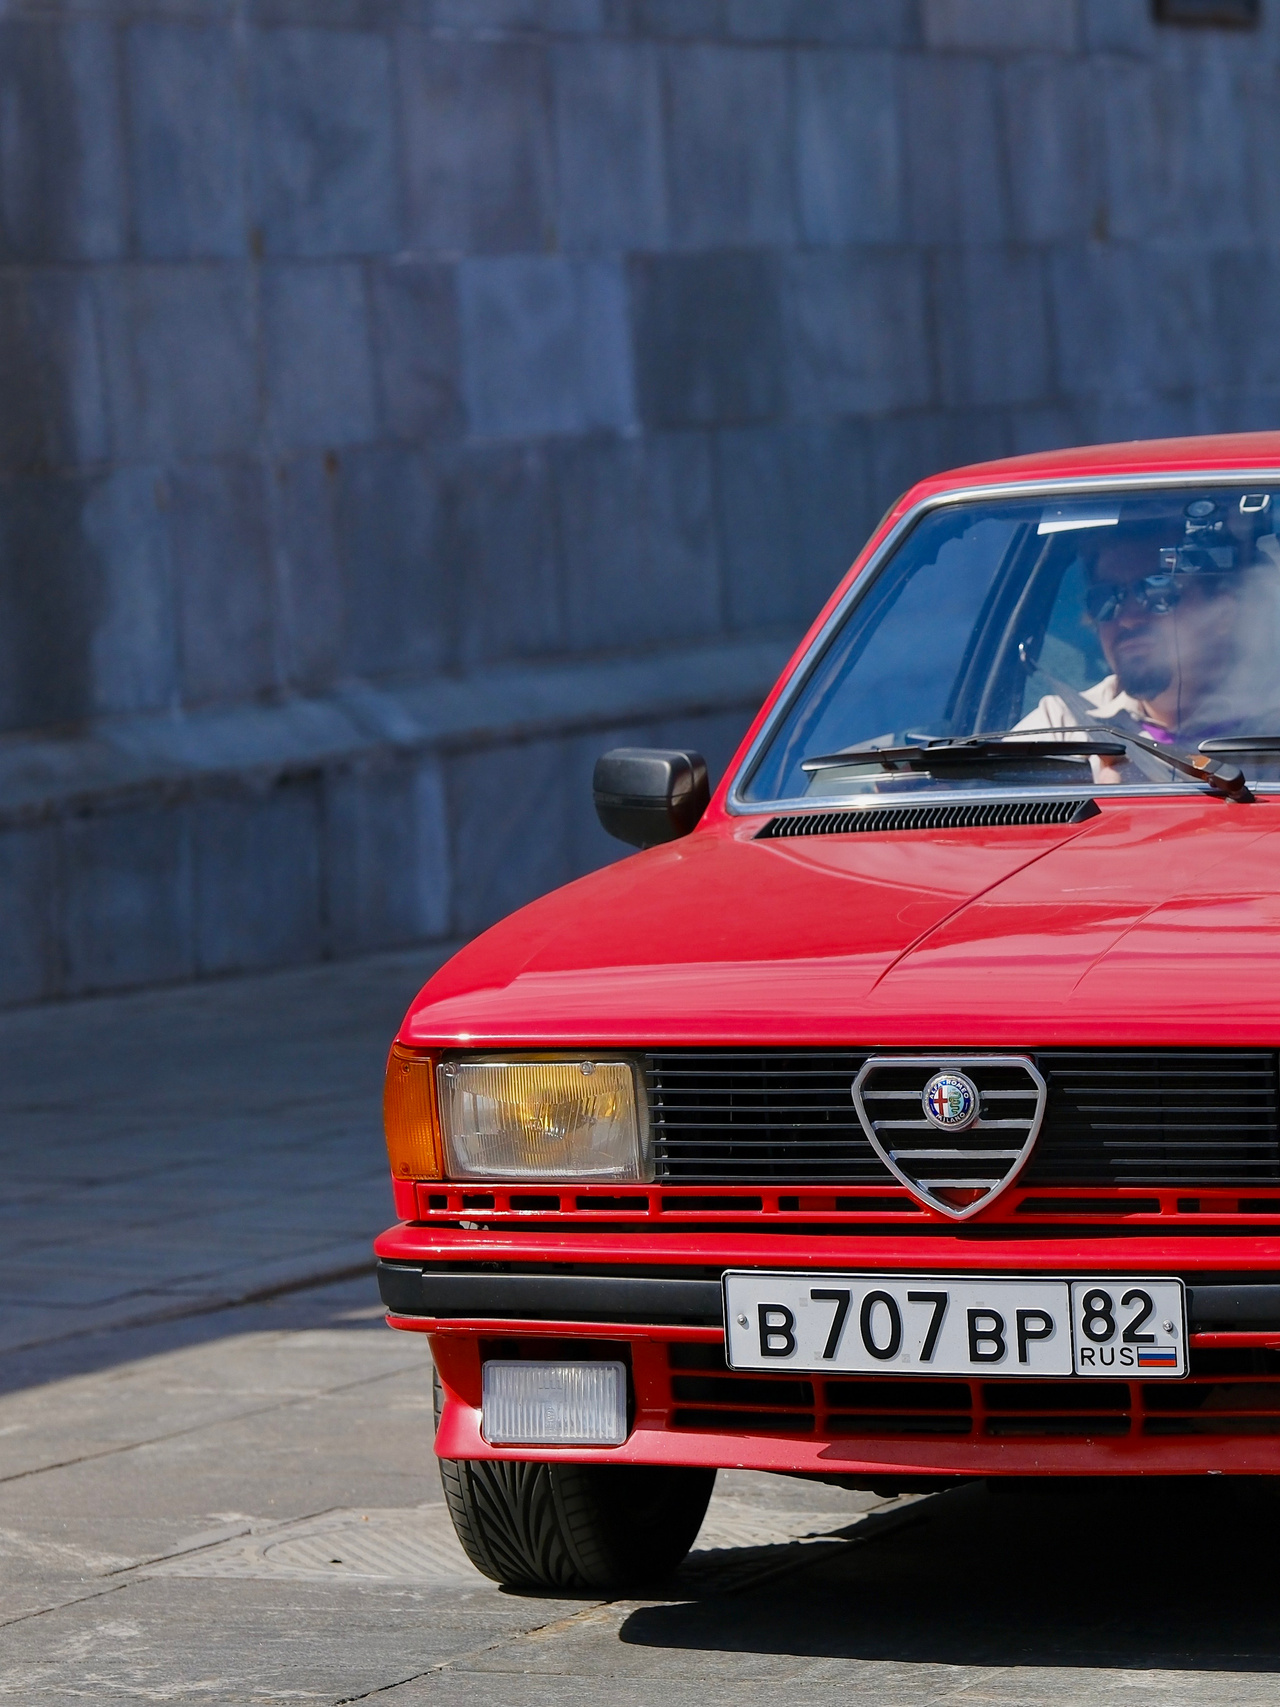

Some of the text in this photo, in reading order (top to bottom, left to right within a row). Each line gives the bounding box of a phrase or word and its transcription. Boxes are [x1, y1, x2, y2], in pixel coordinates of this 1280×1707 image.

[929, 1080, 970, 1099] ALFA ROMEO
[935, 1112, 966, 1123] MILANO
[1082, 1288, 1155, 1343] 82
[1081, 1346, 1135, 1366] RUS
